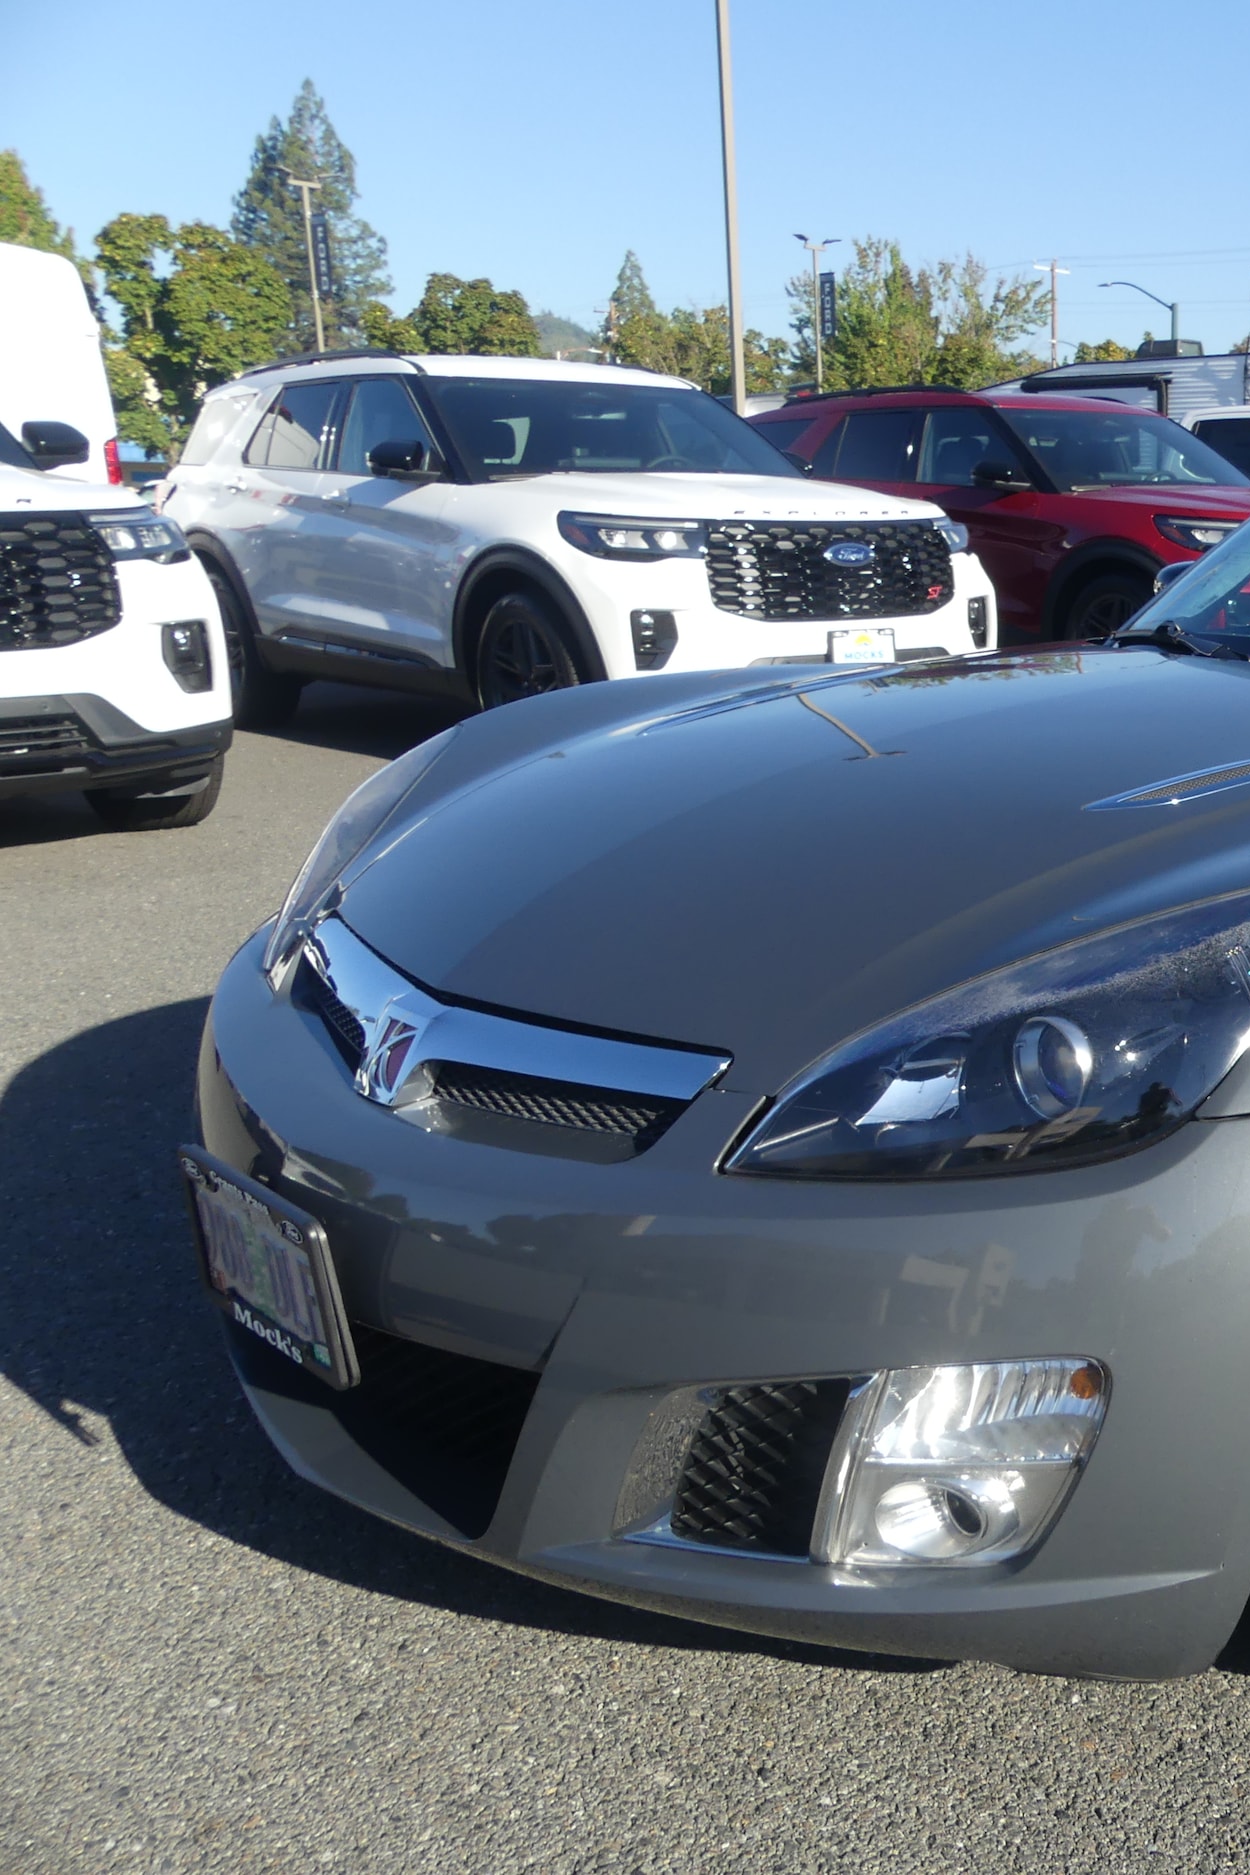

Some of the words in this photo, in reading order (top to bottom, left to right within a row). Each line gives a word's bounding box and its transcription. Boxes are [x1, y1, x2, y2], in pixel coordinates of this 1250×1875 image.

[824, 283, 832, 334] FORD
[837, 549, 866, 561] Ford
[926, 585, 943, 599] ST
[844, 651, 884, 659] MOCKS
[233, 1301, 303, 1364] Mock's
